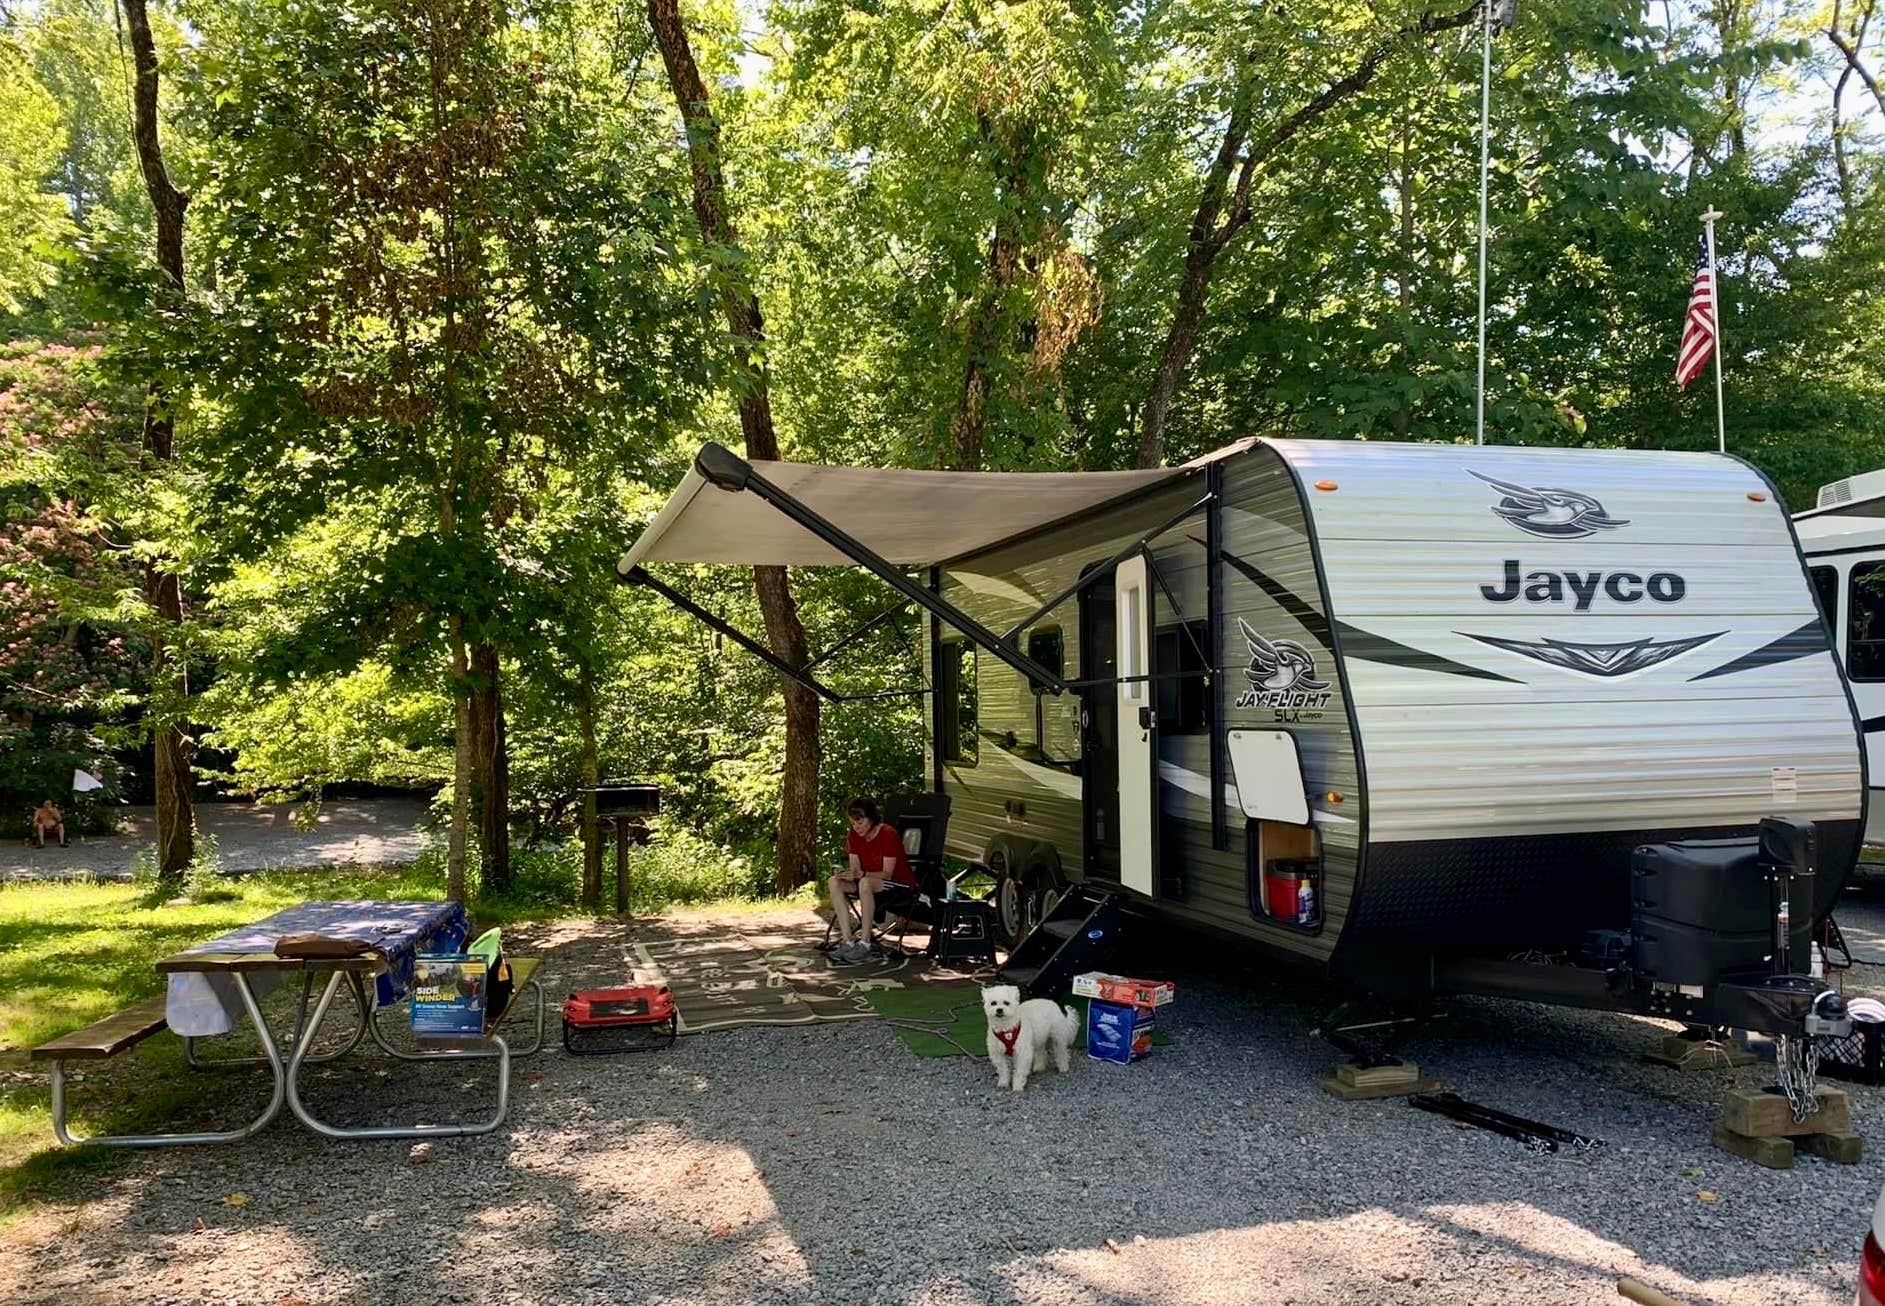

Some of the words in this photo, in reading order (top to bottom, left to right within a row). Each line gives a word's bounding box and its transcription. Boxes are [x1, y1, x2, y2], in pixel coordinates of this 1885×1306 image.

[1480, 559, 1686, 611] Jayco
[1274, 709, 1300, 722] SLX
[416, 986, 440, 994] SIDE
[415, 993, 456, 1002] WINDER
